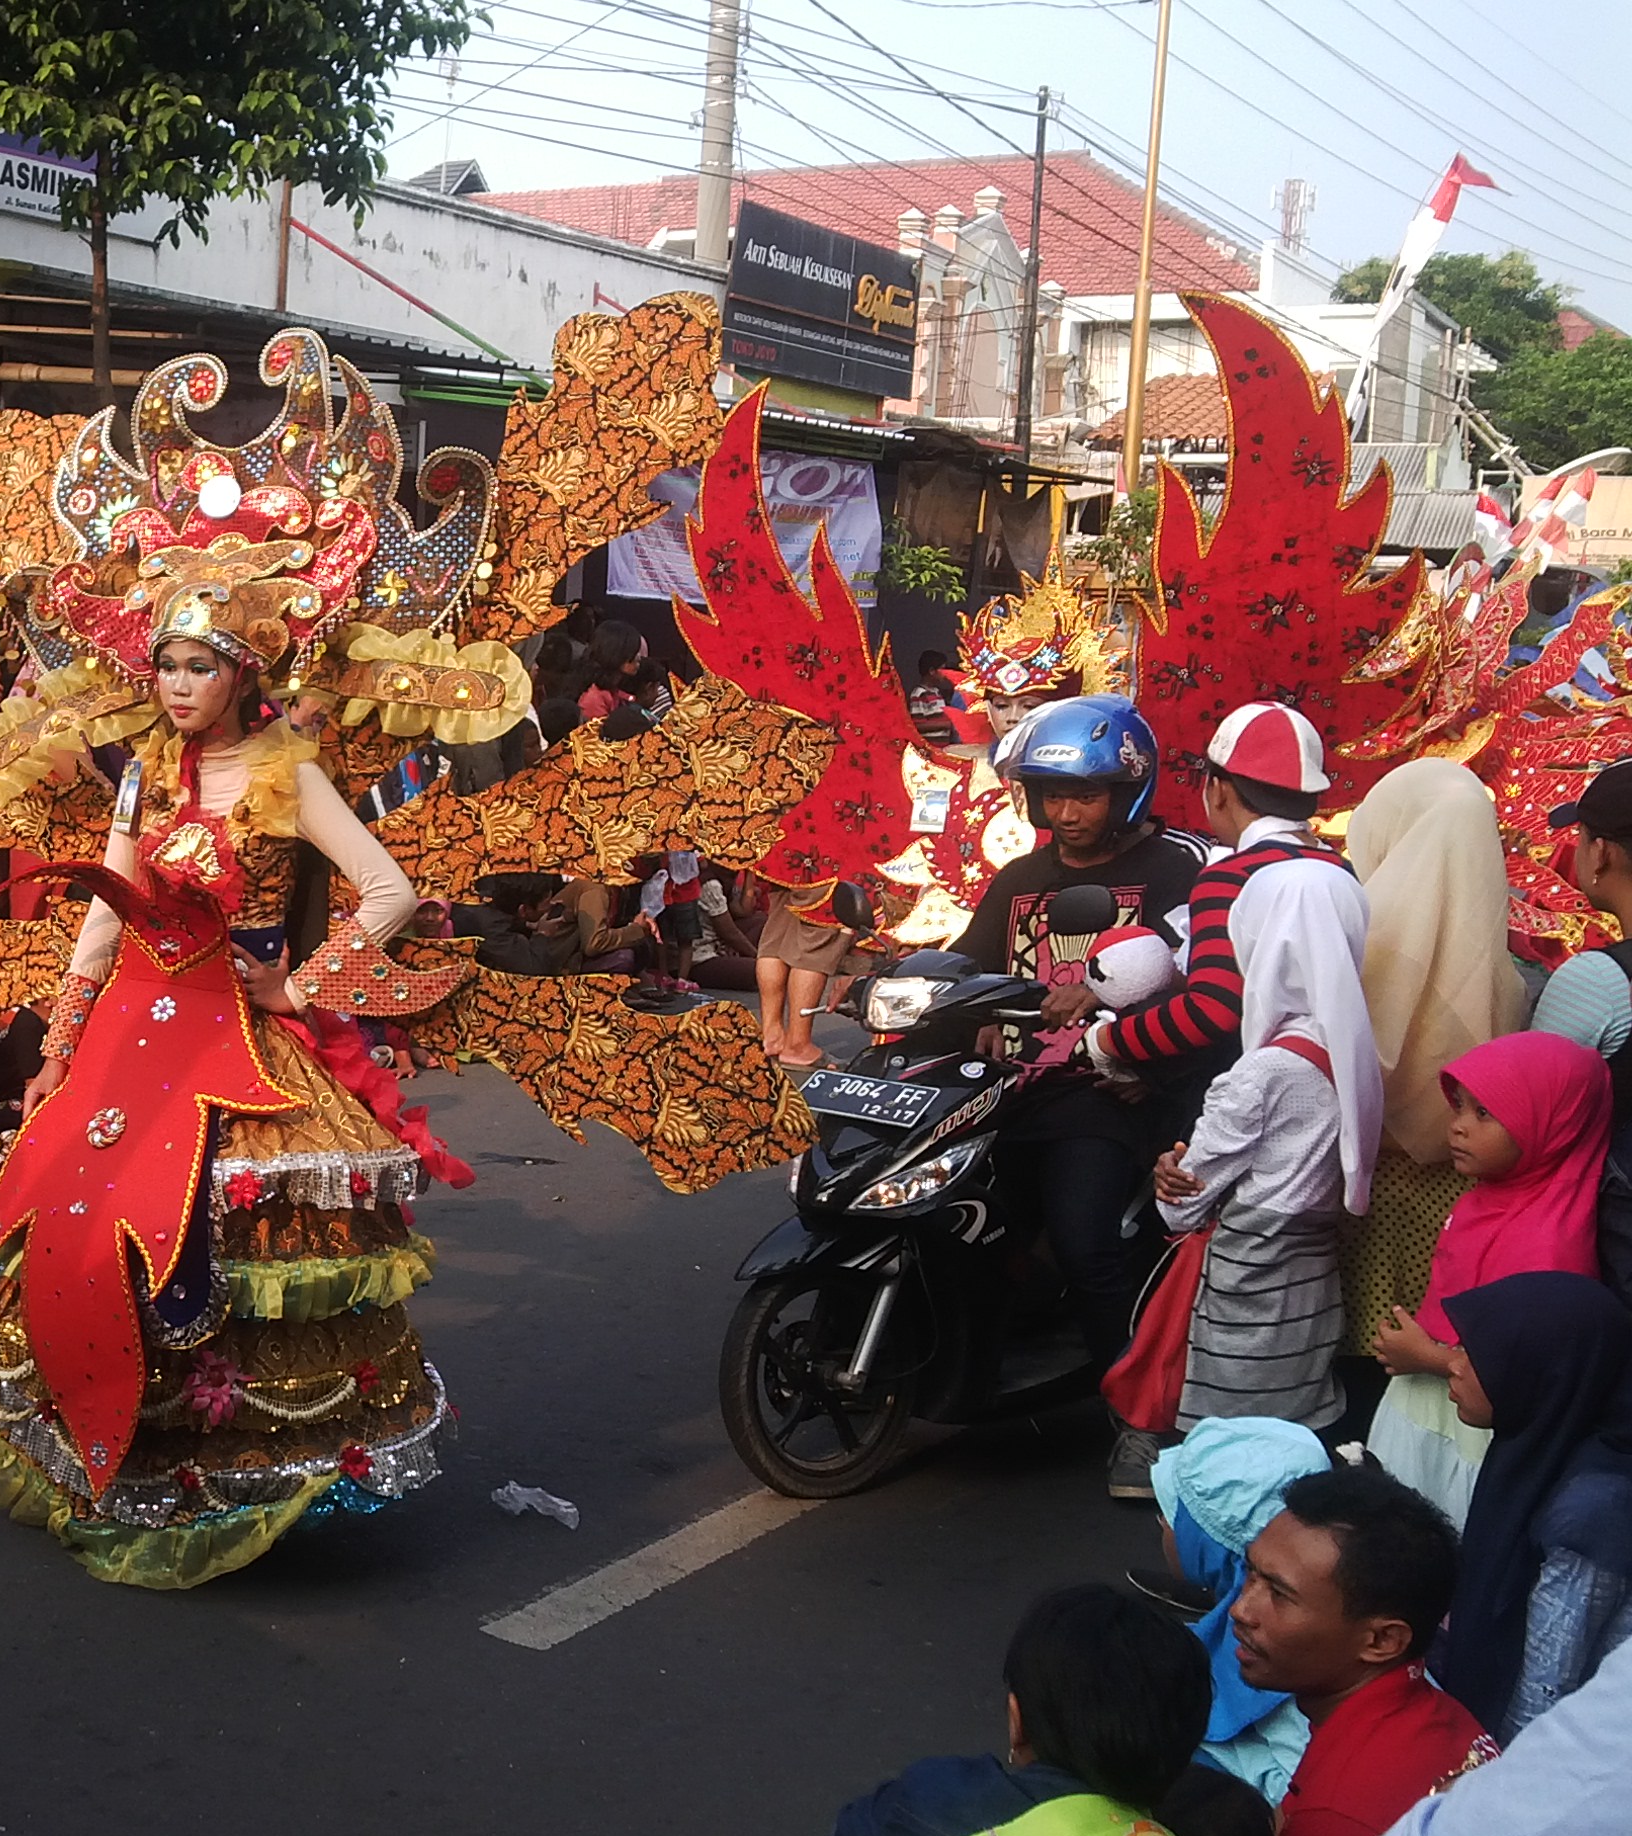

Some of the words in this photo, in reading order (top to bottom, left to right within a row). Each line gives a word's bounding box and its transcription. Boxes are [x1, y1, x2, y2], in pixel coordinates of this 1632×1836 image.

[1580, 528, 1617, 538] Bara
[1036, 748, 1077, 757] INK
[808, 1073, 826, 1089] S
[833, 1078, 888, 1099] 3064
[893, 1087, 928, 1106] FF
